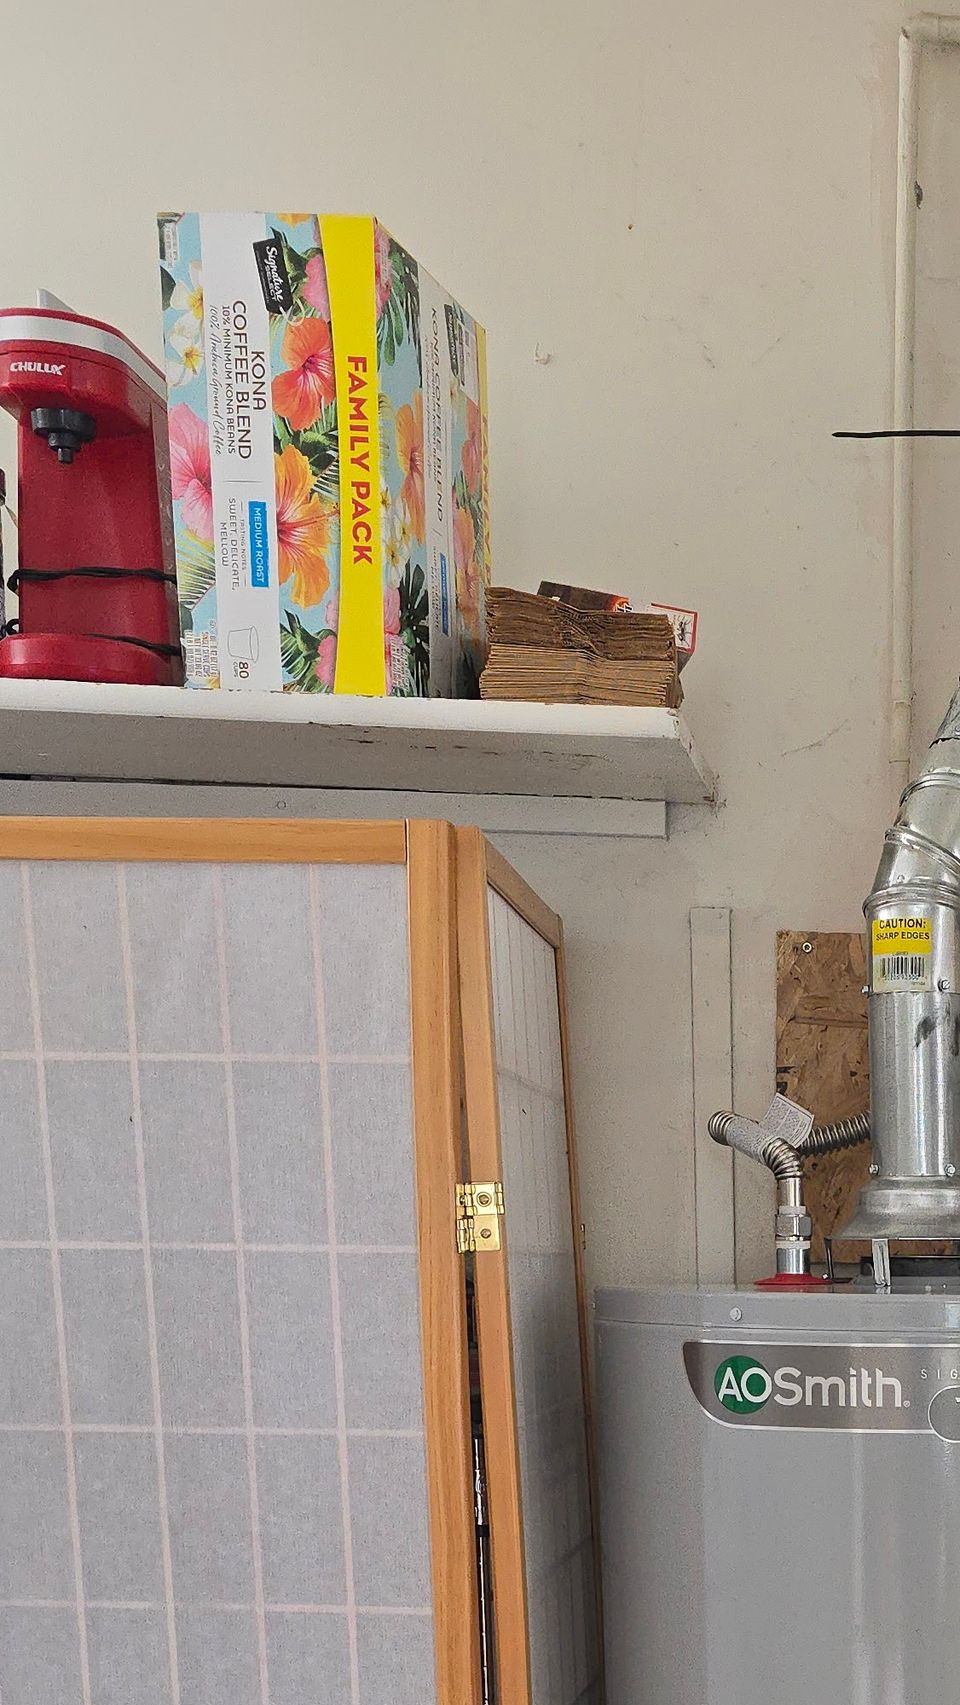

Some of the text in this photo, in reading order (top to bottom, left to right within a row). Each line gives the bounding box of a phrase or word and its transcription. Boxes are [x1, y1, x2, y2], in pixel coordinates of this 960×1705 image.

[266, 245, 283, 303] Signature
[10, 361, 66, 376] CHULUX
[222, 305, 236, 454] 10% MINIMUM KONA BEANS
[232, 300, 251, 459] COFFEE BLEND
[251, 350, 267, 410] KONA
[211, 377, 224, 419] Ground
[212, 420, 225, 455] Coffee
[347, 356, 372, 565] FAMILY PACK
[220, 522, 229, 567] MELLOW
[230, 540, 240, 591] DELICATE,
[254, 507, 265, 583] MEDIUM ROAST
[239, 661, 249, 679] 80
[876, 931, 930, 941] SHARP EDGES
[879, 918, 926, 930] CAUTION:
